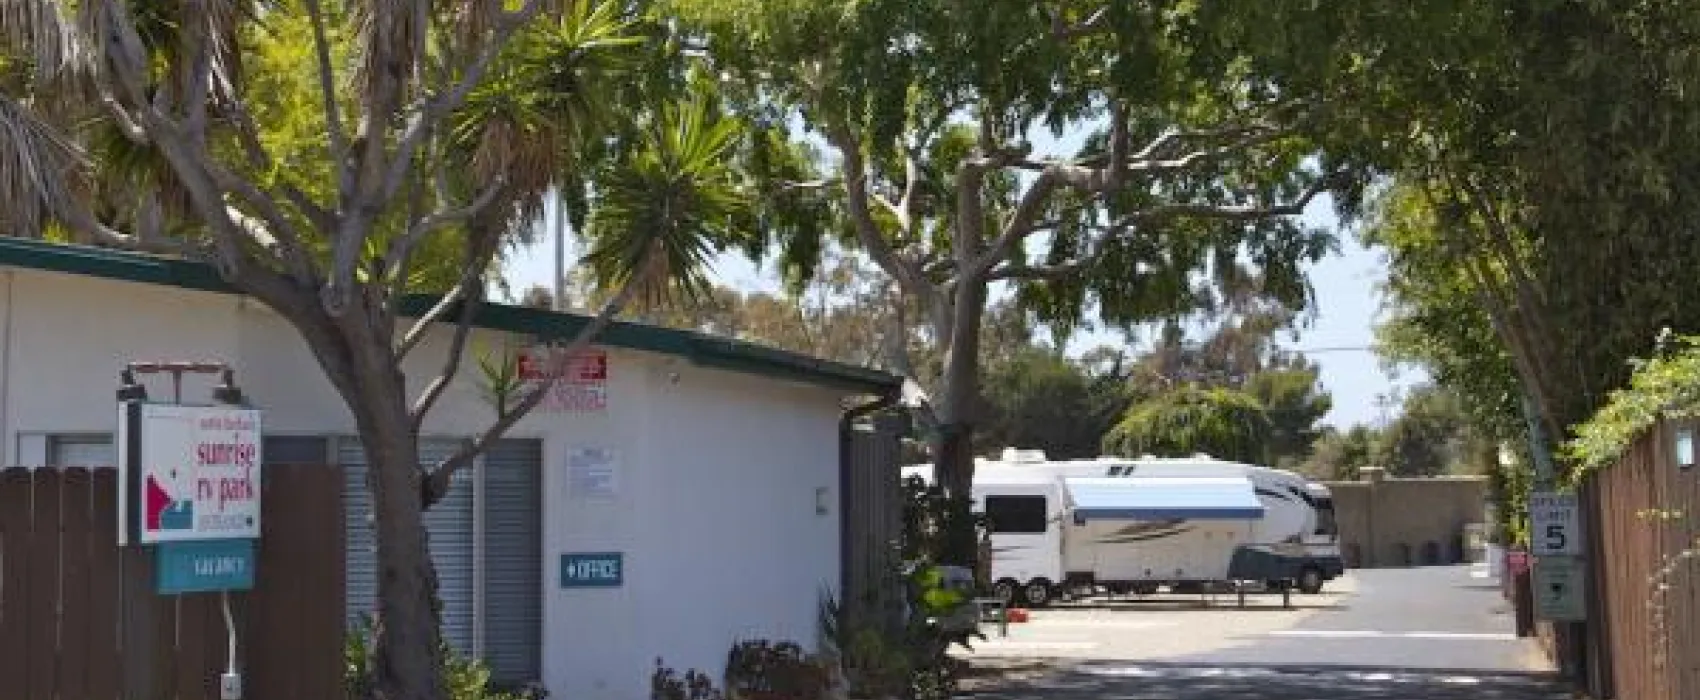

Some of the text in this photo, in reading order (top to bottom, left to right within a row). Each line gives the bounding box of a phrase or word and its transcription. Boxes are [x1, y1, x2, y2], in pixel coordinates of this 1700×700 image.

[197, 432, 255, 466] sunrise
[197, 466, 253, 512] rv park
[1546, 525, 1565, 549] 5
[577, 559, 619, 577] OFFICE
